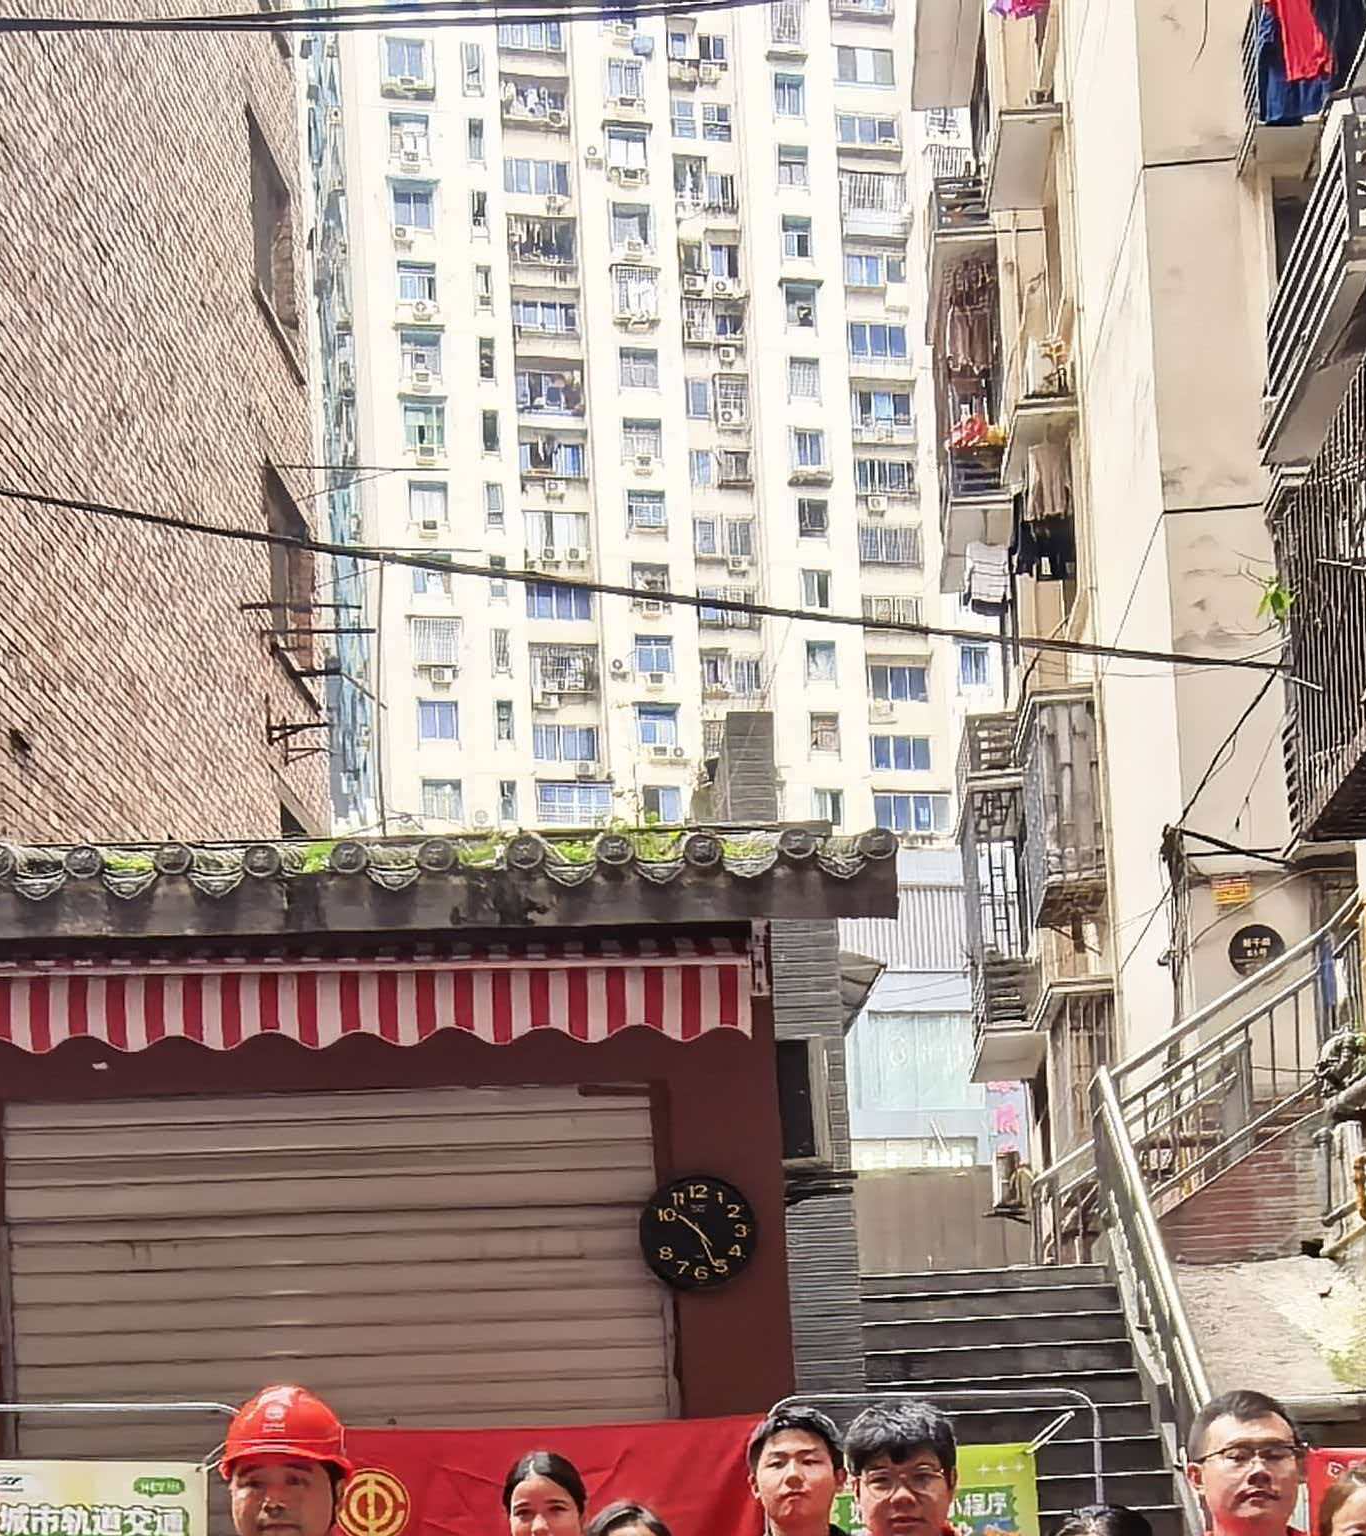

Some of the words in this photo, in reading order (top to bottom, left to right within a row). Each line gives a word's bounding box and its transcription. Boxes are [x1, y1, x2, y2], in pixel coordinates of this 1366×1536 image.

[672, 1192, 685, 1206] 11
[689, 1185, 708, 1199] 12
[716, 1192, 724, 1204] 1
[658, 1208, 676, 1222] 10
[726, 1205, 741, 1218] 2
[734, 1224, 748, 1238] 3
[659, 1246, 674, 1260] 8
[728, 1244, 742, 1257] 4
[676, 1261, 690, 1274] 7
[695, 1266, 708, 1280] 6
[714, 1259, 728, 1273] 5
